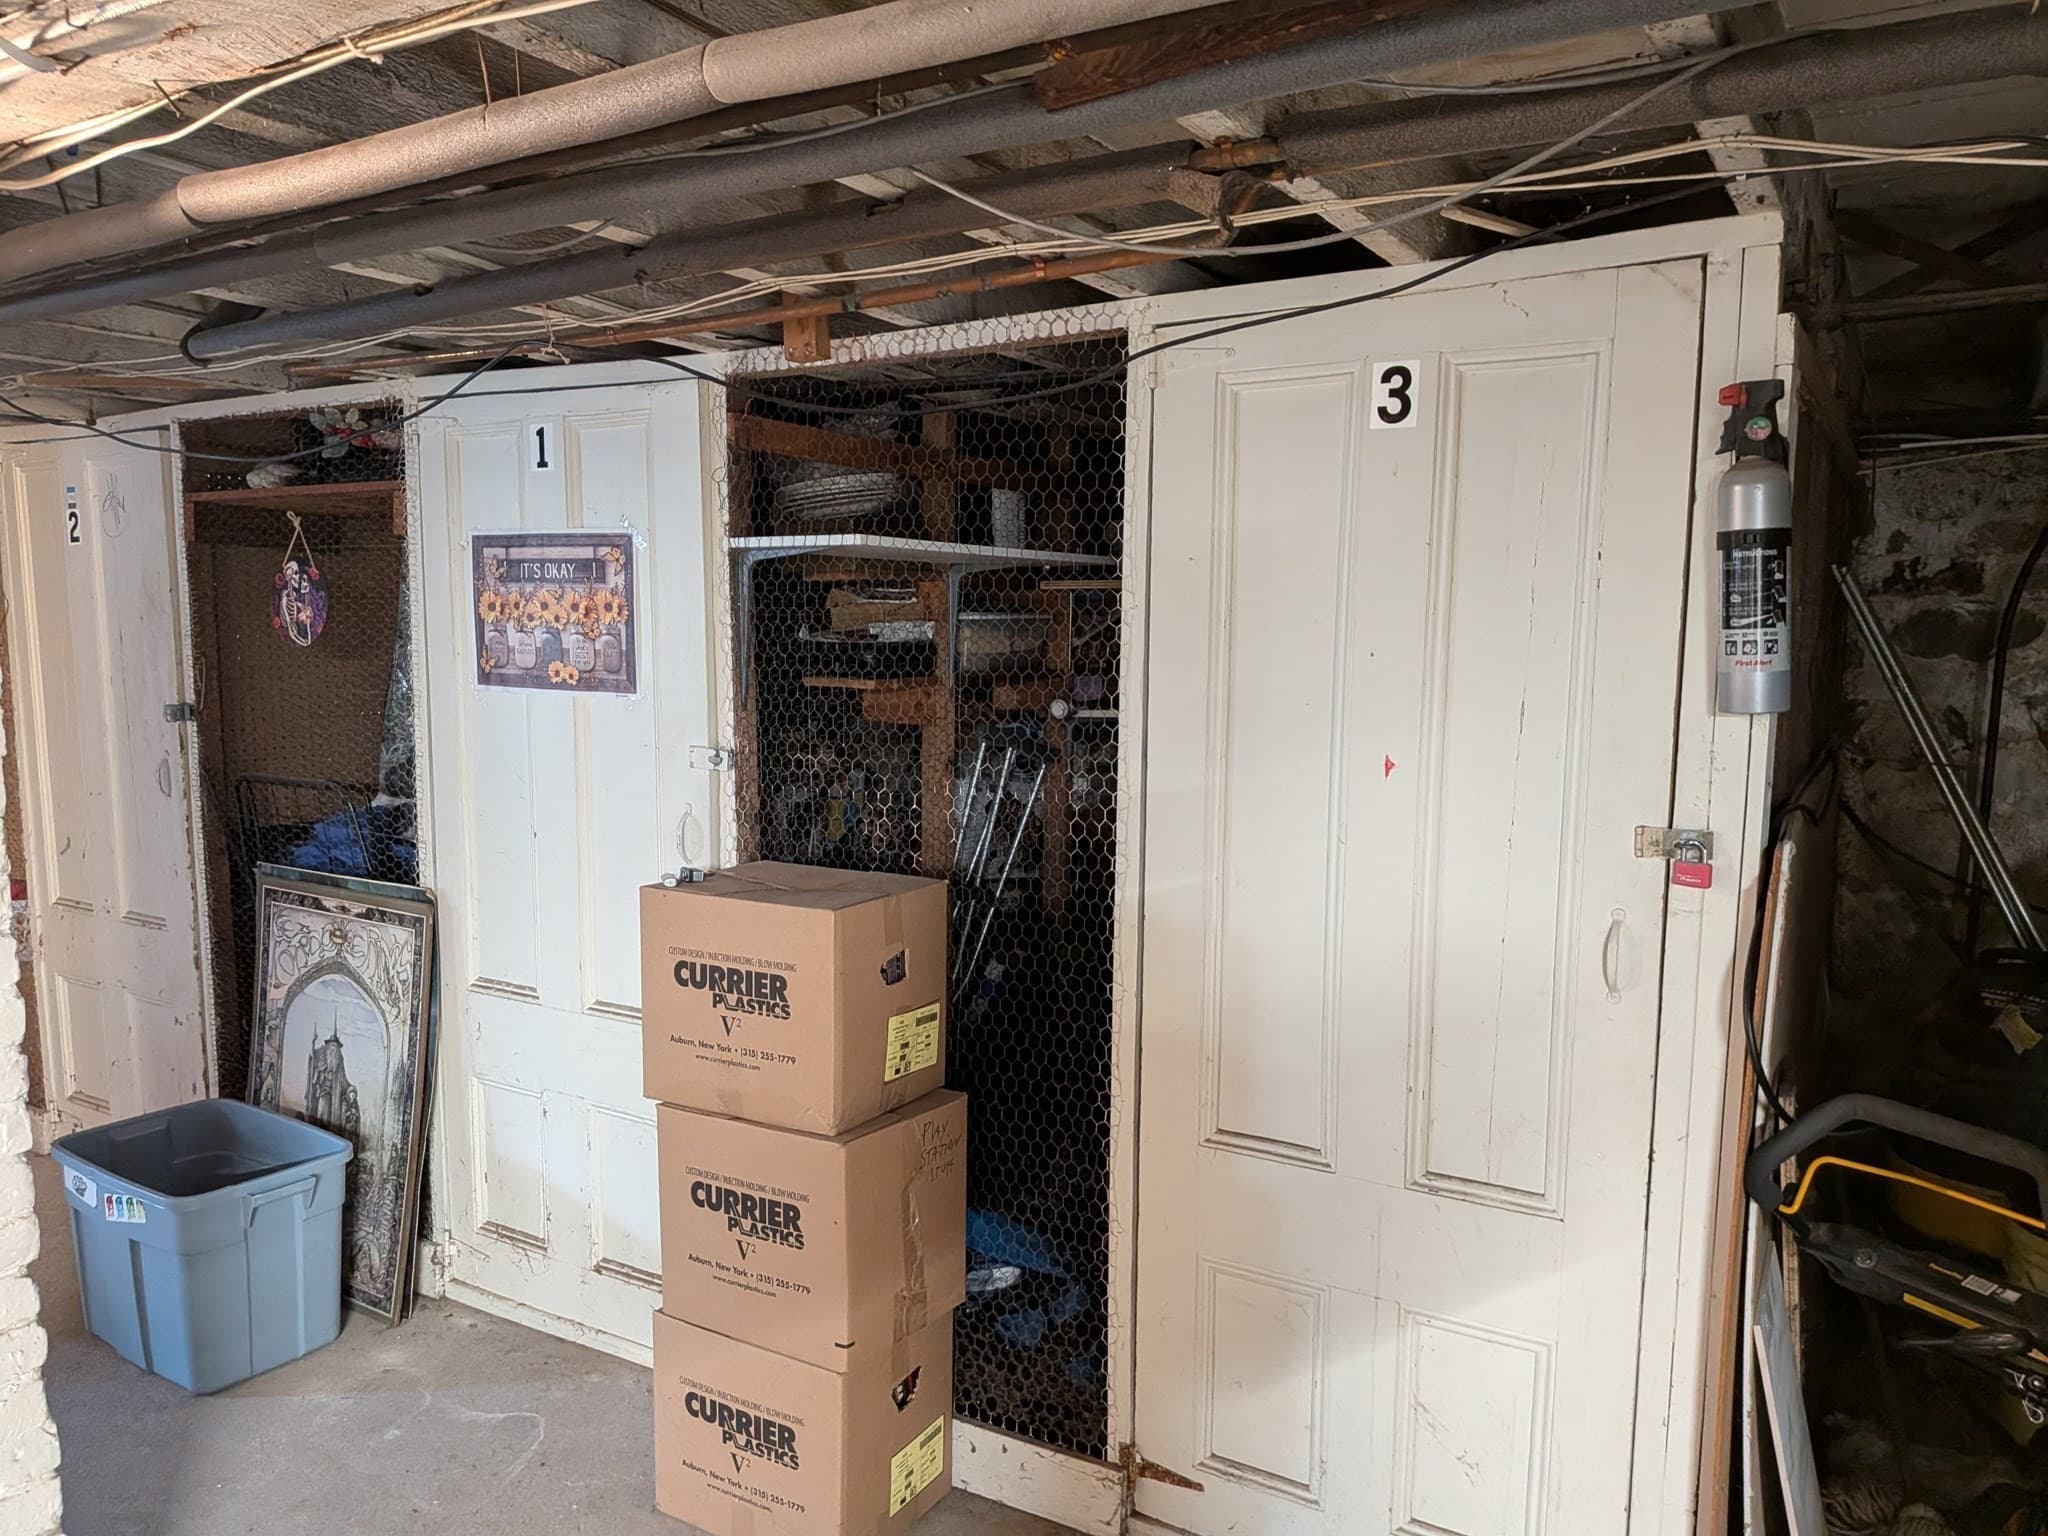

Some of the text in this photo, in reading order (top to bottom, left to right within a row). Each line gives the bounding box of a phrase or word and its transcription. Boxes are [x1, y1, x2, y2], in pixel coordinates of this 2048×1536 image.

[1377, 365, 1412, 424] 3
[536, 426, 548, 469] 1
[68, 511, 80, 543] 2
[520, 562, 576, 579] IT'S OKAY
[668, 946, 688, 956] CUSTOM
[688, 948, 705, 959] DESIGN
[708, 951, 732, 962] INJECTION
[732, 954, 754, 966] MOLDING
[757, 958, 772, 968] BLOW
[773, 960, 797, 972] MOLDING
[674, 960, 788, 1003] CURRIER
[712, 992, 791, 1020] PLASTICS
[670, 1034, 796, 1065] Auburn, New York (315) 255-1779
[696, 1054, 760, 1072] www.currierplastics.com
[685, 1166, 703, 1177] CUSTOM
[704, 1170, 720, 1181] DESIGN
[723, 1175, 745, 1188] INJECTION
[746, 1180, 768, 1194] MOLDING
[771, 1187, 786, 1198] BLOW
[786, 1190, 810, 1204] MOLDING
[690, 1180, 802, 1233] CURRIER
[728, 1216, 804, 1250] PLASTICS
[688, 1253, 811, 1295] Auburn, New York (315) 255-1779
[712, 1274, 776, 1298] www.currierplastics.com
[680, 1376, 697, 1389] CUSTOM
[698, 1382, 714, 1395] DESIGN
[718, 1390, 740, 1404] INJECTION
[740, 1399, 763, 1413] MOLDING
[766, 1407, 781, 1418] BLOW
[781, 1411, 805, 1427] MOLDING
[684, 1391, 797, 1454] CURRIER
[722, 1429, 800, 1470] PLASTICS
[682, 1459, 806, 1513] Auburn, New York (315) 255-1779
